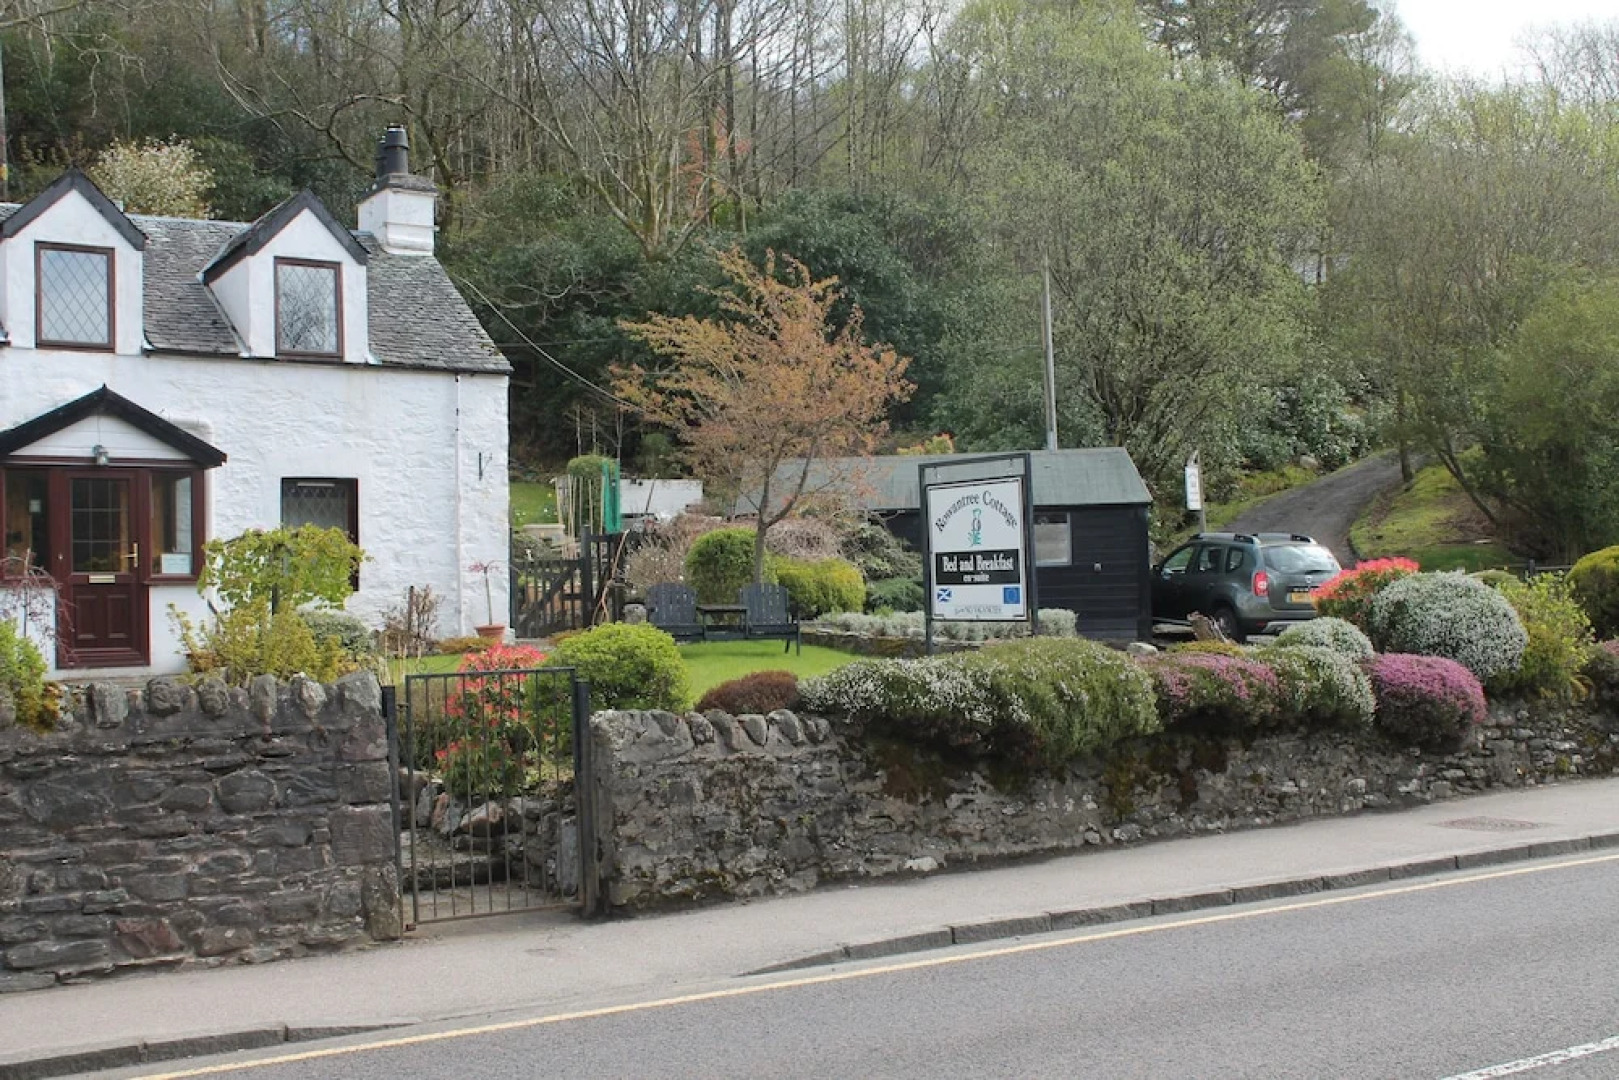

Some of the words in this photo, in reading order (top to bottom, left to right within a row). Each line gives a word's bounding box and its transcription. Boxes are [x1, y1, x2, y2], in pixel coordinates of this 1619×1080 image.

[935, 494, 980, 532] Rowantree
[982, 490, 1018, 529] Cottage
[942, 556, 957, 572] Bed
[960, 555, 973, 571] and
[976, 553, 1013, 571] Breakfast
